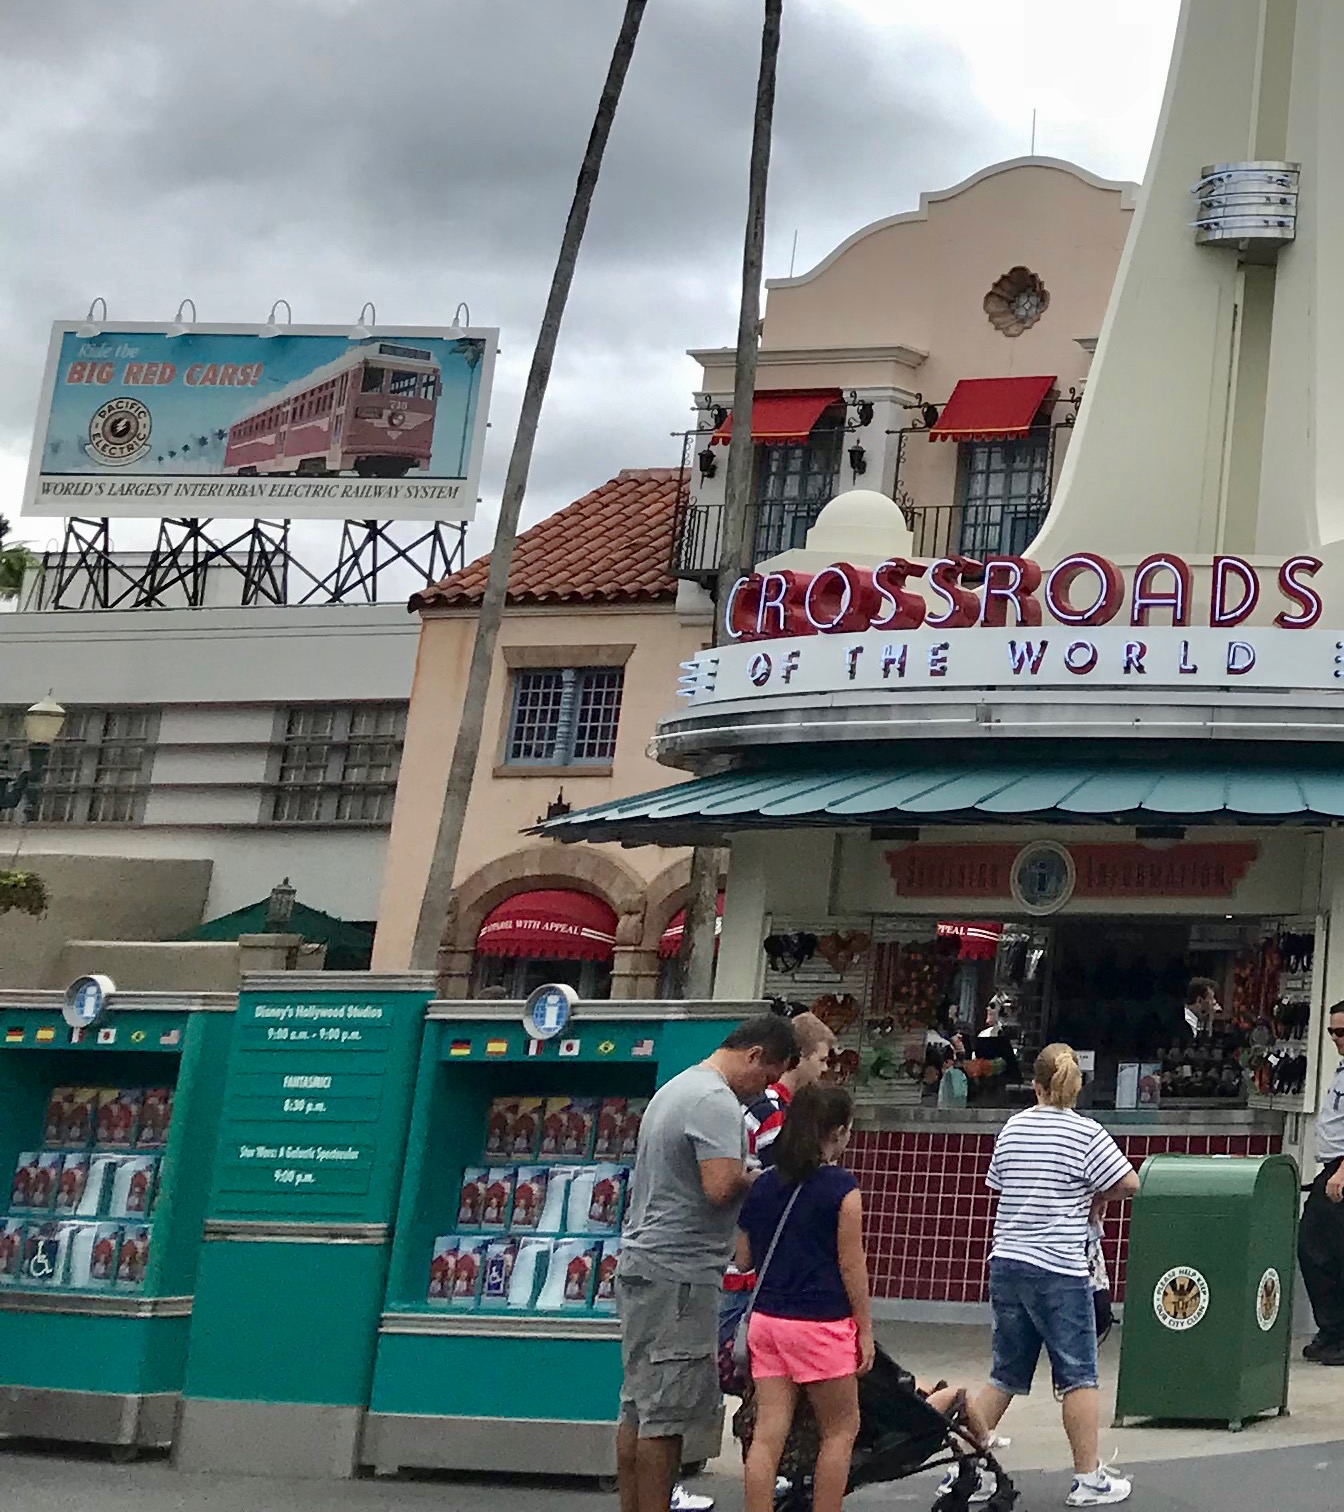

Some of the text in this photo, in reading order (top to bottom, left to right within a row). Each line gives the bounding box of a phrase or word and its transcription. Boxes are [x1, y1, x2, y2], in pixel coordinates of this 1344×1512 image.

[78, 343, 140, 359] Ride the
[65, 361, 264, 387] BIG RED CARS!
[98, 400, 148, 421] PACIFIC
[91, 431, 148, 456] ELECTRIC
[41, 481, 460, 499] WORLD'S LARGEST INTERURBAN ELECTRIC RAILWAY SYSTEM
[724, 551, 1324, 639] CROSSROADS
[747, 639, 1257, 687] OF THE WORLD
[515, 919, 541, 930] WITH
[542, 921, 580, 936] APPEAL
[254, 1005, 383, 1021] Disney's Hollywood Studios
[267, 1027, 289, 1041] 9:00
[289, 1031, 310, 1041] a.m.
[319, 1027, 340, 1040] 9:00
[341, 1031, 362, 1043] p.m.
[283, 1098, 327, 1115] 8:30 p.m.
[239, 1145, 256, 1159] Star
[285, 1146, 315, 1159] Galactic
[315, 1146, 360, 1162] Spectacular
[273, 1168, 316, 1186] 9:00 p.m.
[1156, 1270, 1177, 1295] PLEASE
[1178, 1268, 1198, 1278] HELP
[1168, 1318, 1186, 1328] CITY
[1186, 1305, 1205, 1326] CLEAN
